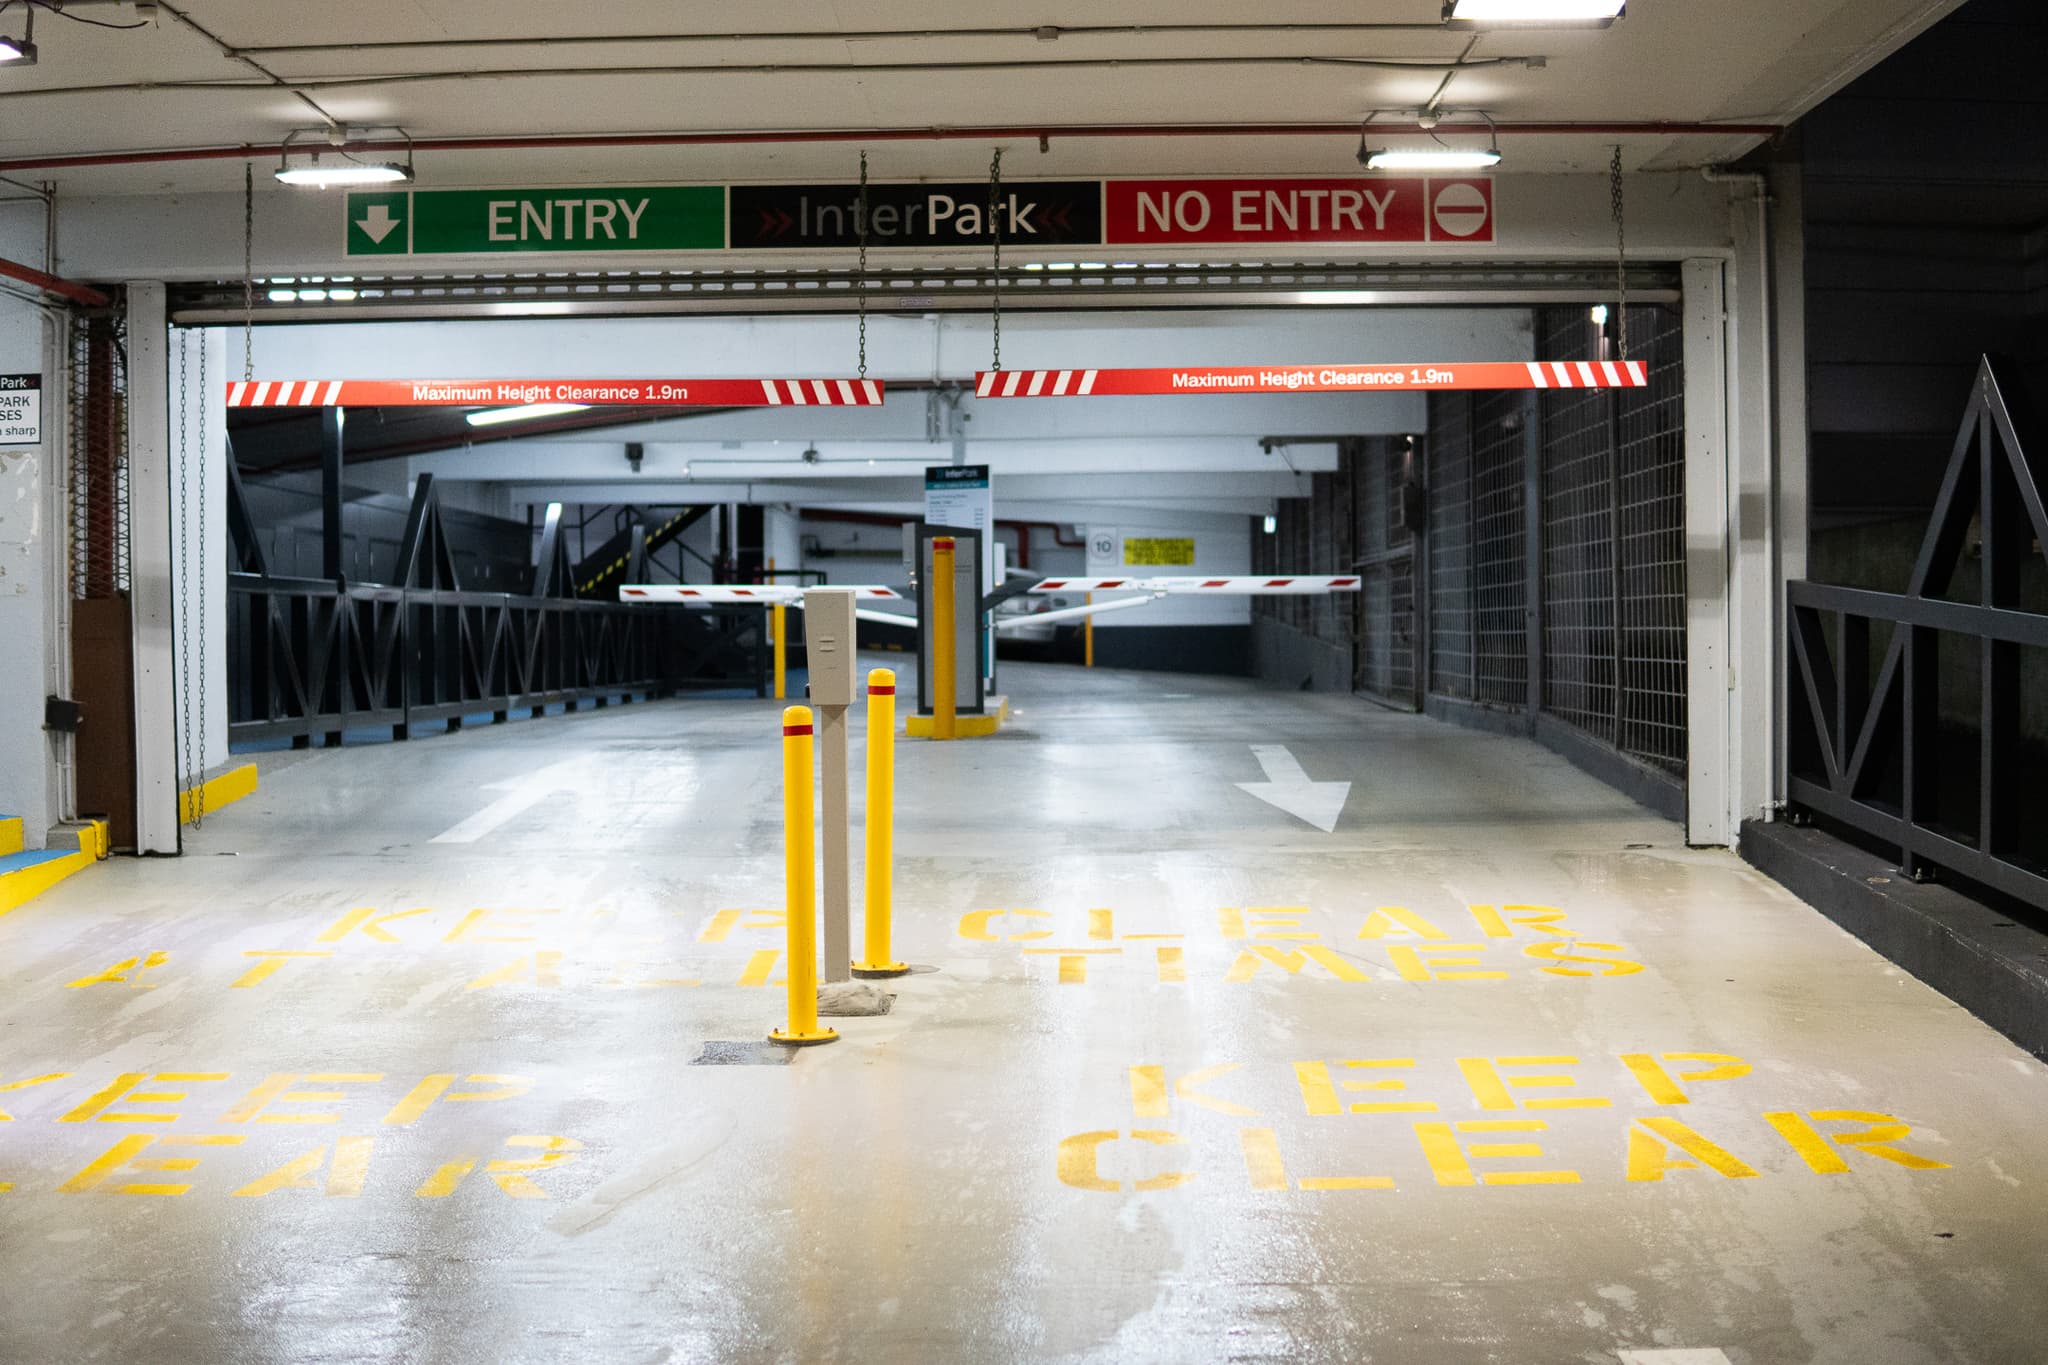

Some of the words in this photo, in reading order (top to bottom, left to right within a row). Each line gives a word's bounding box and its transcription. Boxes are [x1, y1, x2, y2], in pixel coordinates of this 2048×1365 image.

[488, 198, 650, 241] ENTRY
[800, 193, 1038, 237] InterPark
[1137, 190, 1211, 232] NO
[1232, 189, 1396, 231] ENTRY
[413, 385, 492, 401] Maximum
[497, 384, 551, 403] Height
[555, 384, 639, 400] Clearance
[644, 384, 688, 400] 1.9m
[1172, 373, 1255, 388] Maximum
[1259, 371, 1315, 389] Height
[1319, 369, 1405, 385] Clearance
[1409, 368, 1454, 384] 1.9m
[5, 425, 37, 437] sharp
[1095, 540, 1112, 553] 10
[315, 905, 786, 943] KEP
[957, 903, 1585, 940] CLEAR
[1023, 940, 1648, 983] TIMES
[1127, 1051, 1755, 1119] KEEP
[0, 1133, 585, 1198] EAR
[1056, 1109, 1954, 1192] CLEAR
